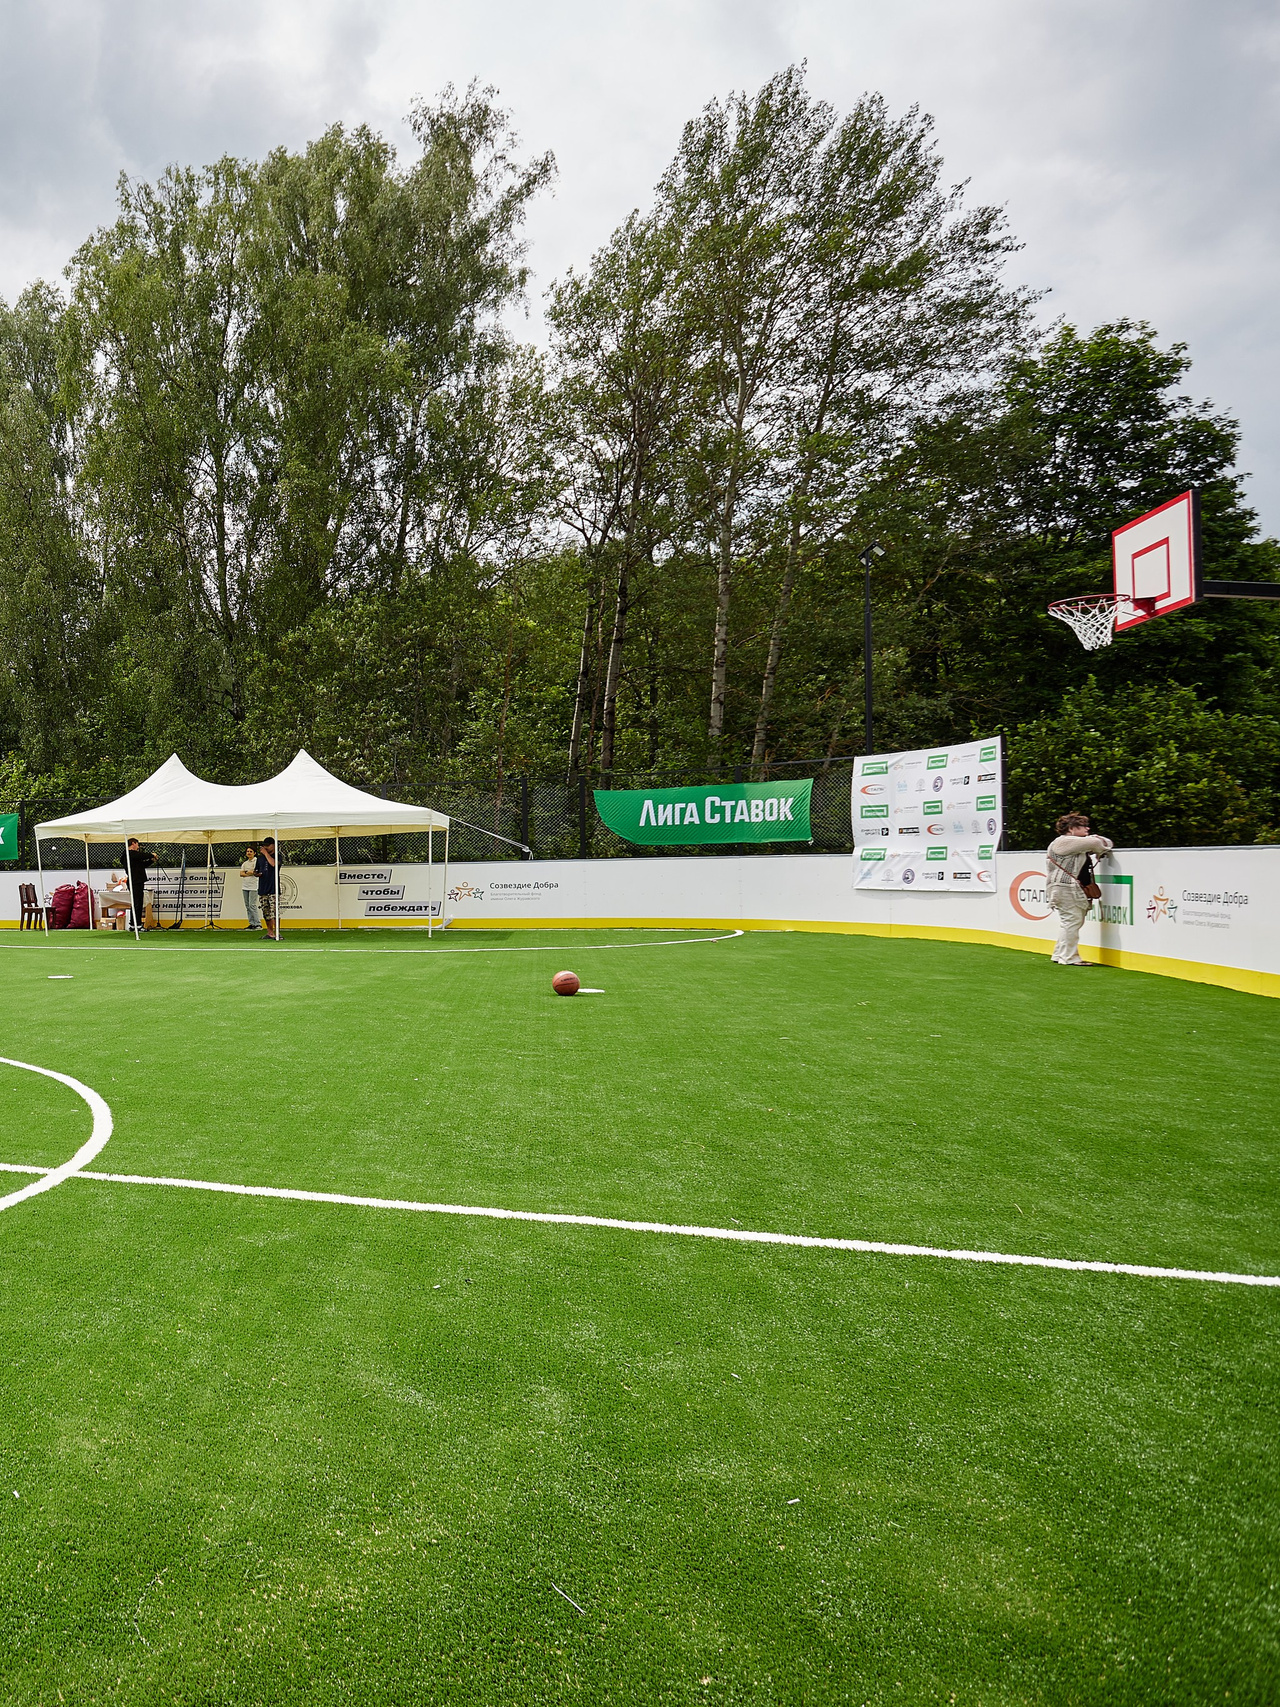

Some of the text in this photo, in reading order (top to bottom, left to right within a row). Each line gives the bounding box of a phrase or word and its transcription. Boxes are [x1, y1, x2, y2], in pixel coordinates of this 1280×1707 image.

[339, 872, 388, 881] Вместе,
[533, 881, 559, 890] Добра
[362, 888, 401, 896] чтобы
[1182, 889, 1248, 908] Созвездие Добра
[368, 904, 437, 913] побеждать
